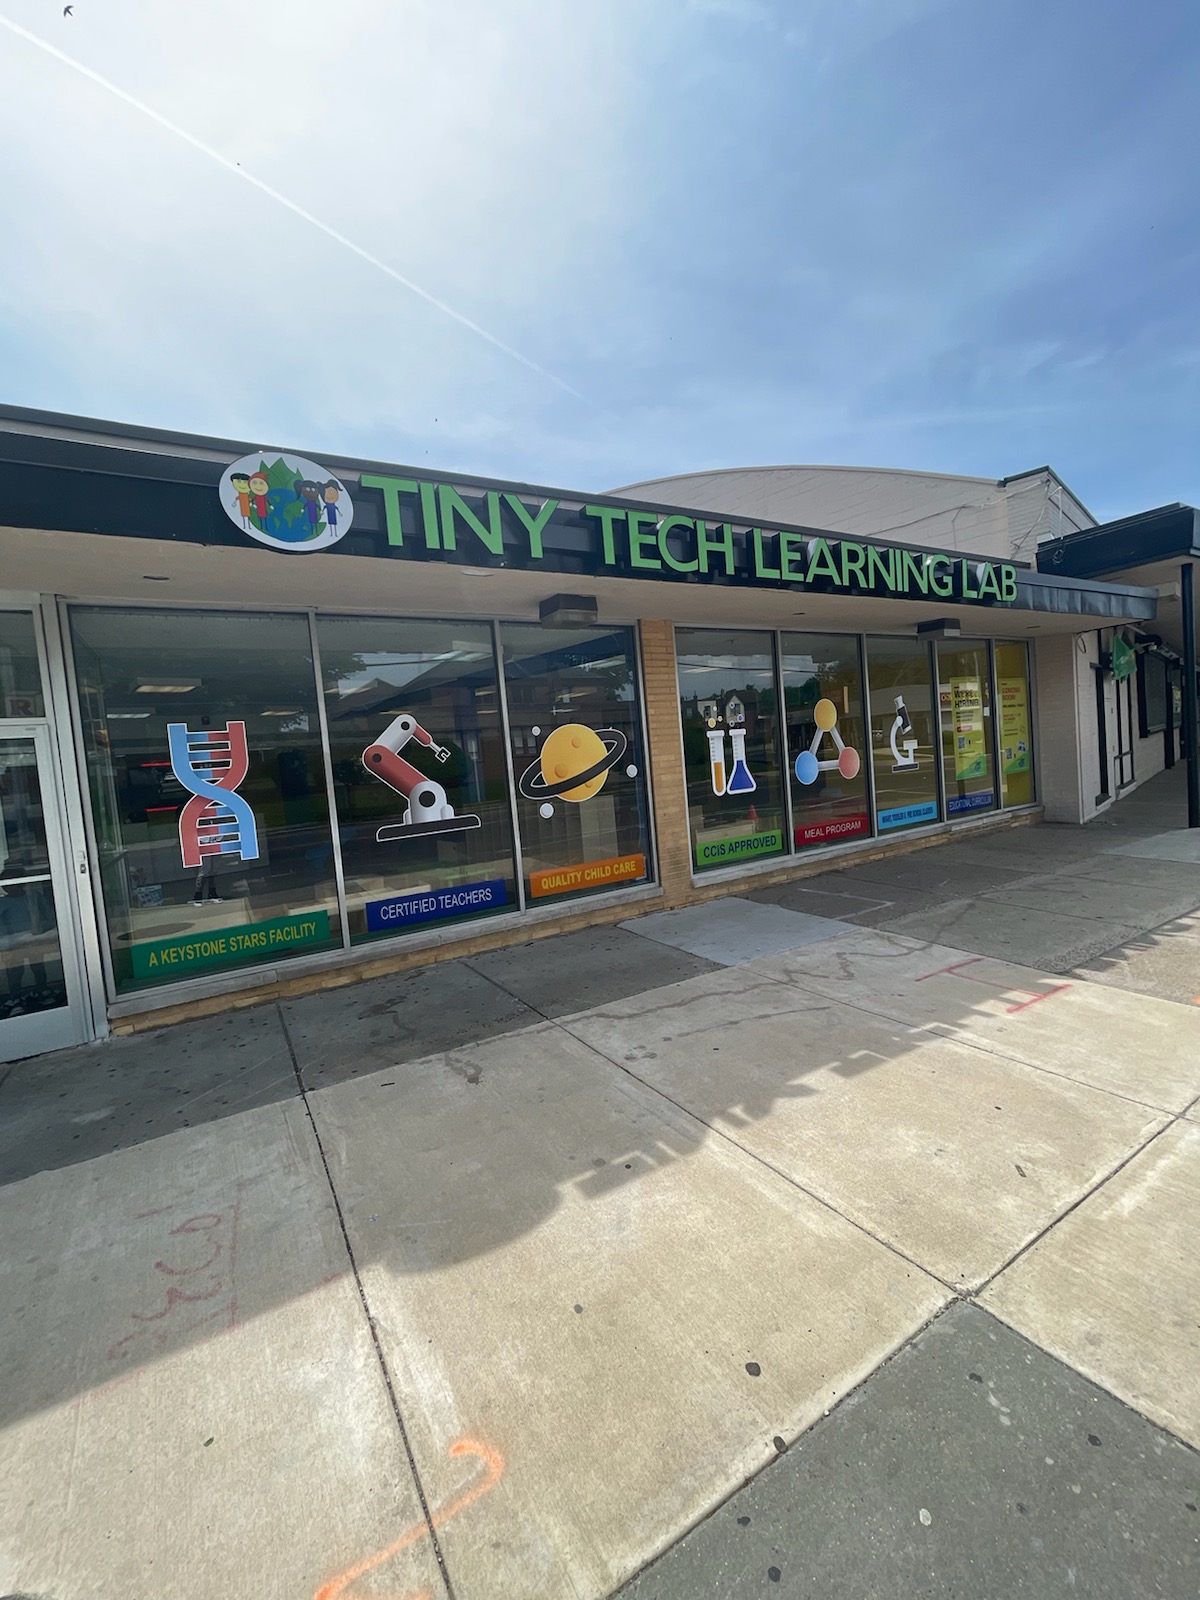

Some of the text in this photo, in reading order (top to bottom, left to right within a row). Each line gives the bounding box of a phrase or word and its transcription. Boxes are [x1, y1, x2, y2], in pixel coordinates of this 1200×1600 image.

[360, 474, 1017, 601] TINY TECH LEARNING LAB
[804, 820, 861, 838] MEAL PROGRAM
[703, 835, 777, 858] CCIS APPROVED
[542, 860, 636, 889] QUALITY CHILD CARE
[380, 888, 493, 920] CERTIFIED TEACHERS
[148, 921, 316, 967] A KEYSTONE STARS FACILITY
